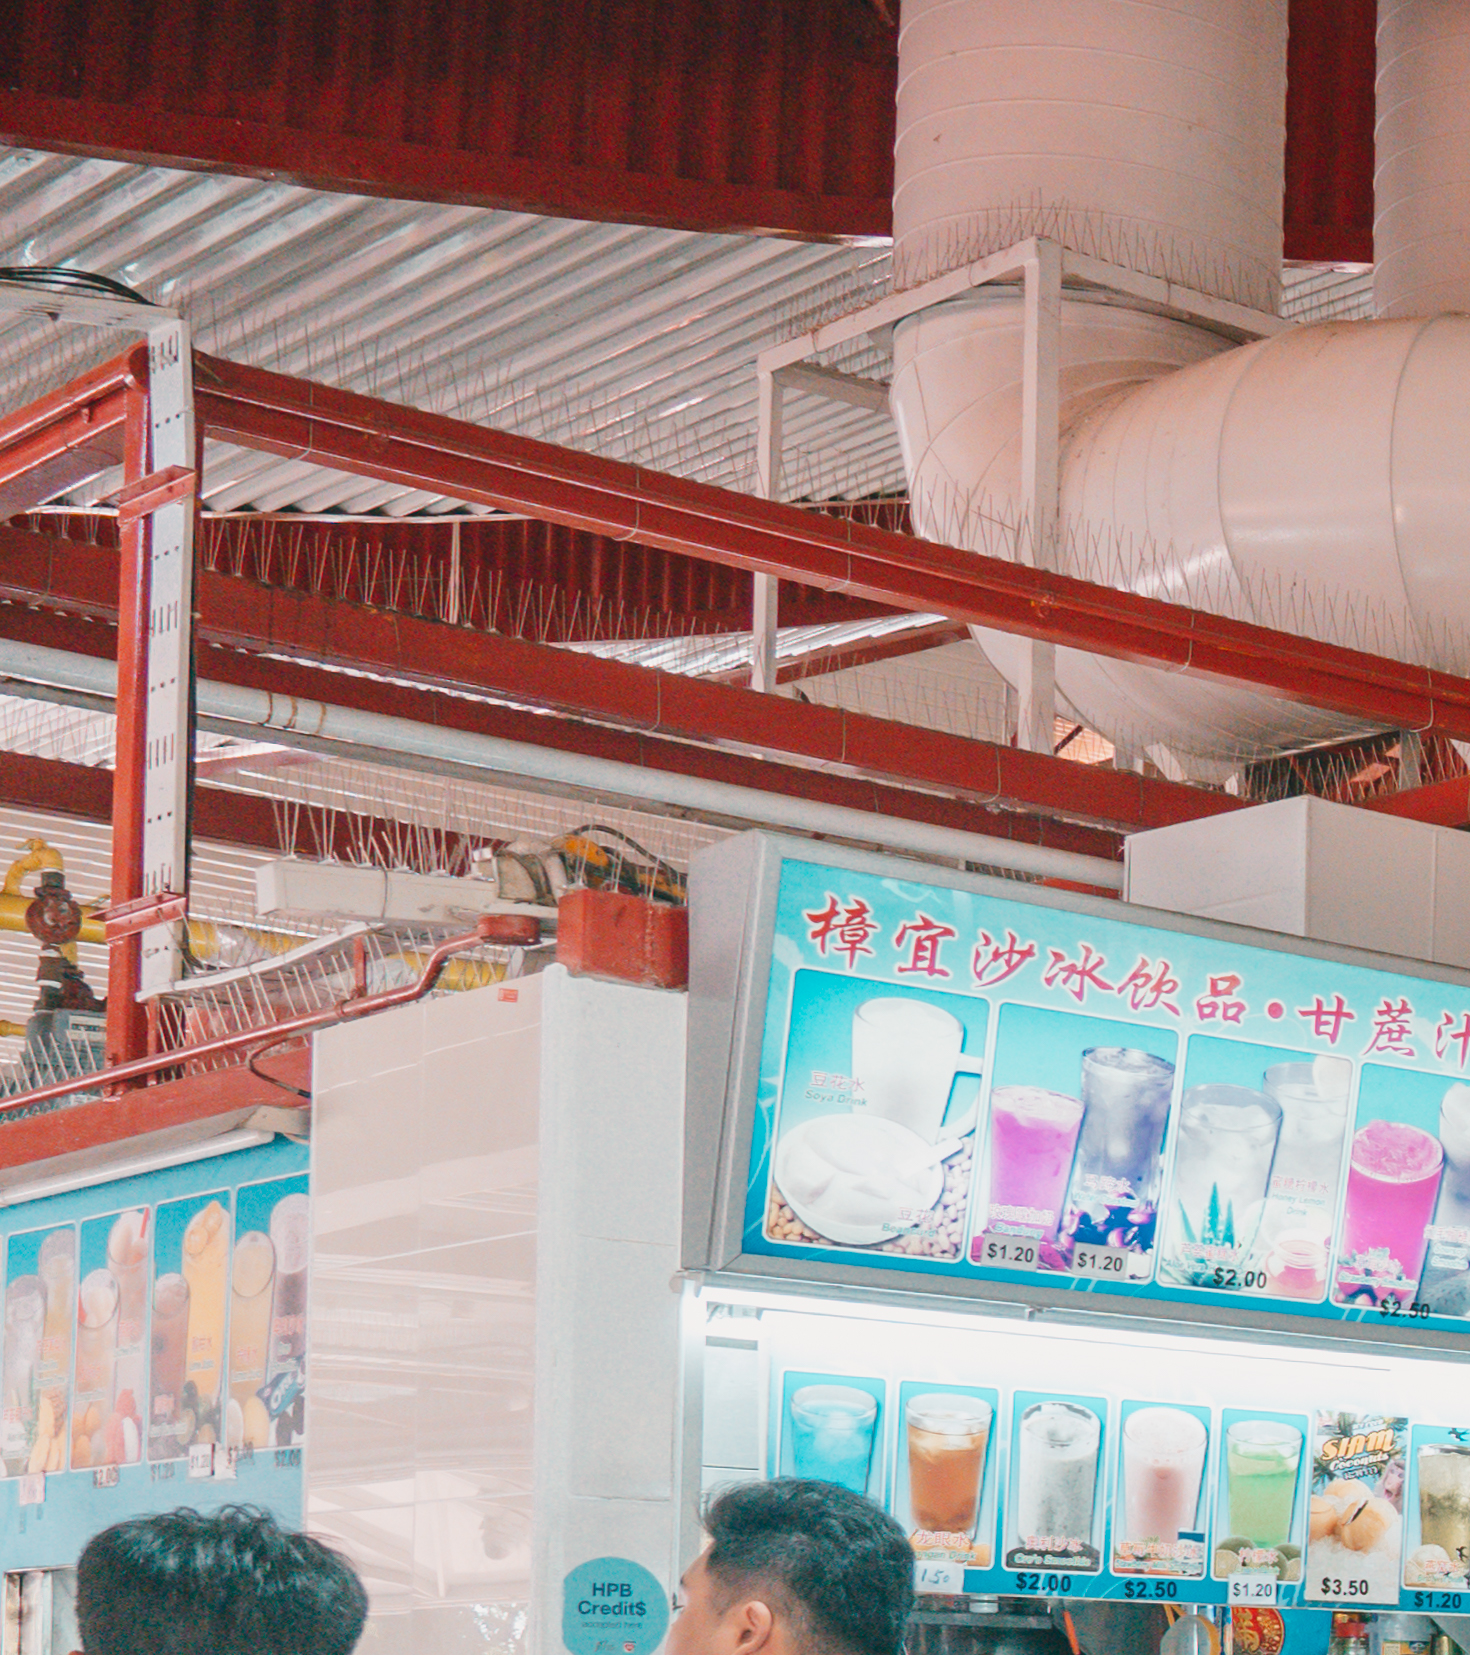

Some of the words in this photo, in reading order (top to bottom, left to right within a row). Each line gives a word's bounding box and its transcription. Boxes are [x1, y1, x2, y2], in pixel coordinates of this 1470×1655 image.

[811, 1071, 866, 1093] 豆花水
[804, 1089, 833, 1104] Soya
[836, 1093, 869, 1107] Drink
[1271, 1192, 1297, 1206] Honey
[1299, 1196, 1326, 1207] Lemon
[897, 1206, 933, 1224] 豆花
[1286, 1206, 1308, 1218] Drink
[986, 1243, 1035, 1264] $1.20
[1077, 1252, 1124, 1273] $1.20
[1212, 1267, 1267, 1289] $2.00
[1379, 1299, 1430, 1320] $2.50
[1329, 1451, 1390, 1472] Coconuts
[592, 1582, 632, 1598] HPB
[1016, 1572, 1071, 1592] $2.00
[1124, 1580, 1177, 1598] $2.50
[1232, 1582, 1272, 1597] $1.20
[1320, 1577, 1369, 1596] $3.50
[577, 1600, 647, 1617] Credit$
[1414, 1591, 1461, 1609] $1.20
